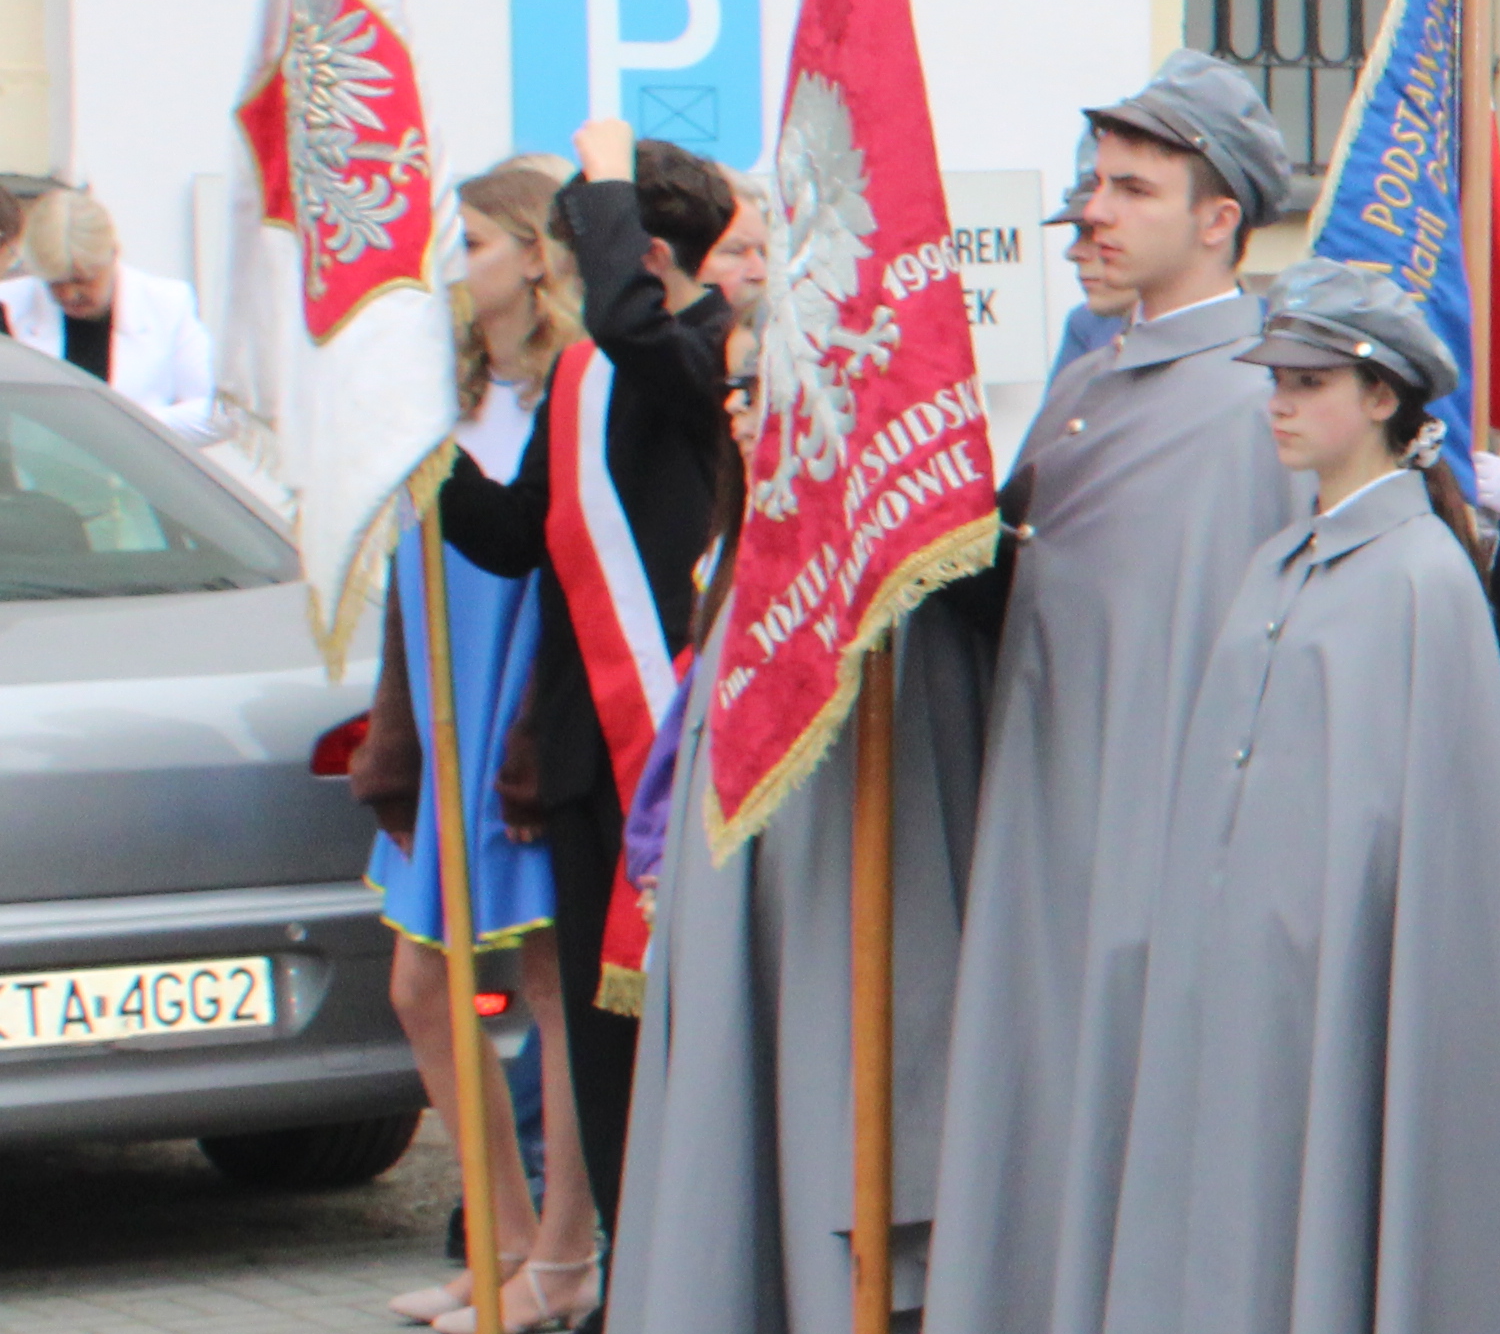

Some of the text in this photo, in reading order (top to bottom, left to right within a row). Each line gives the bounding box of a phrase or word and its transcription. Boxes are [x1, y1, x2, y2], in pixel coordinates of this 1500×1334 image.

[955, 226, 1021, 264] REM
[0, 967, 258, 1040] TA 4GG2
